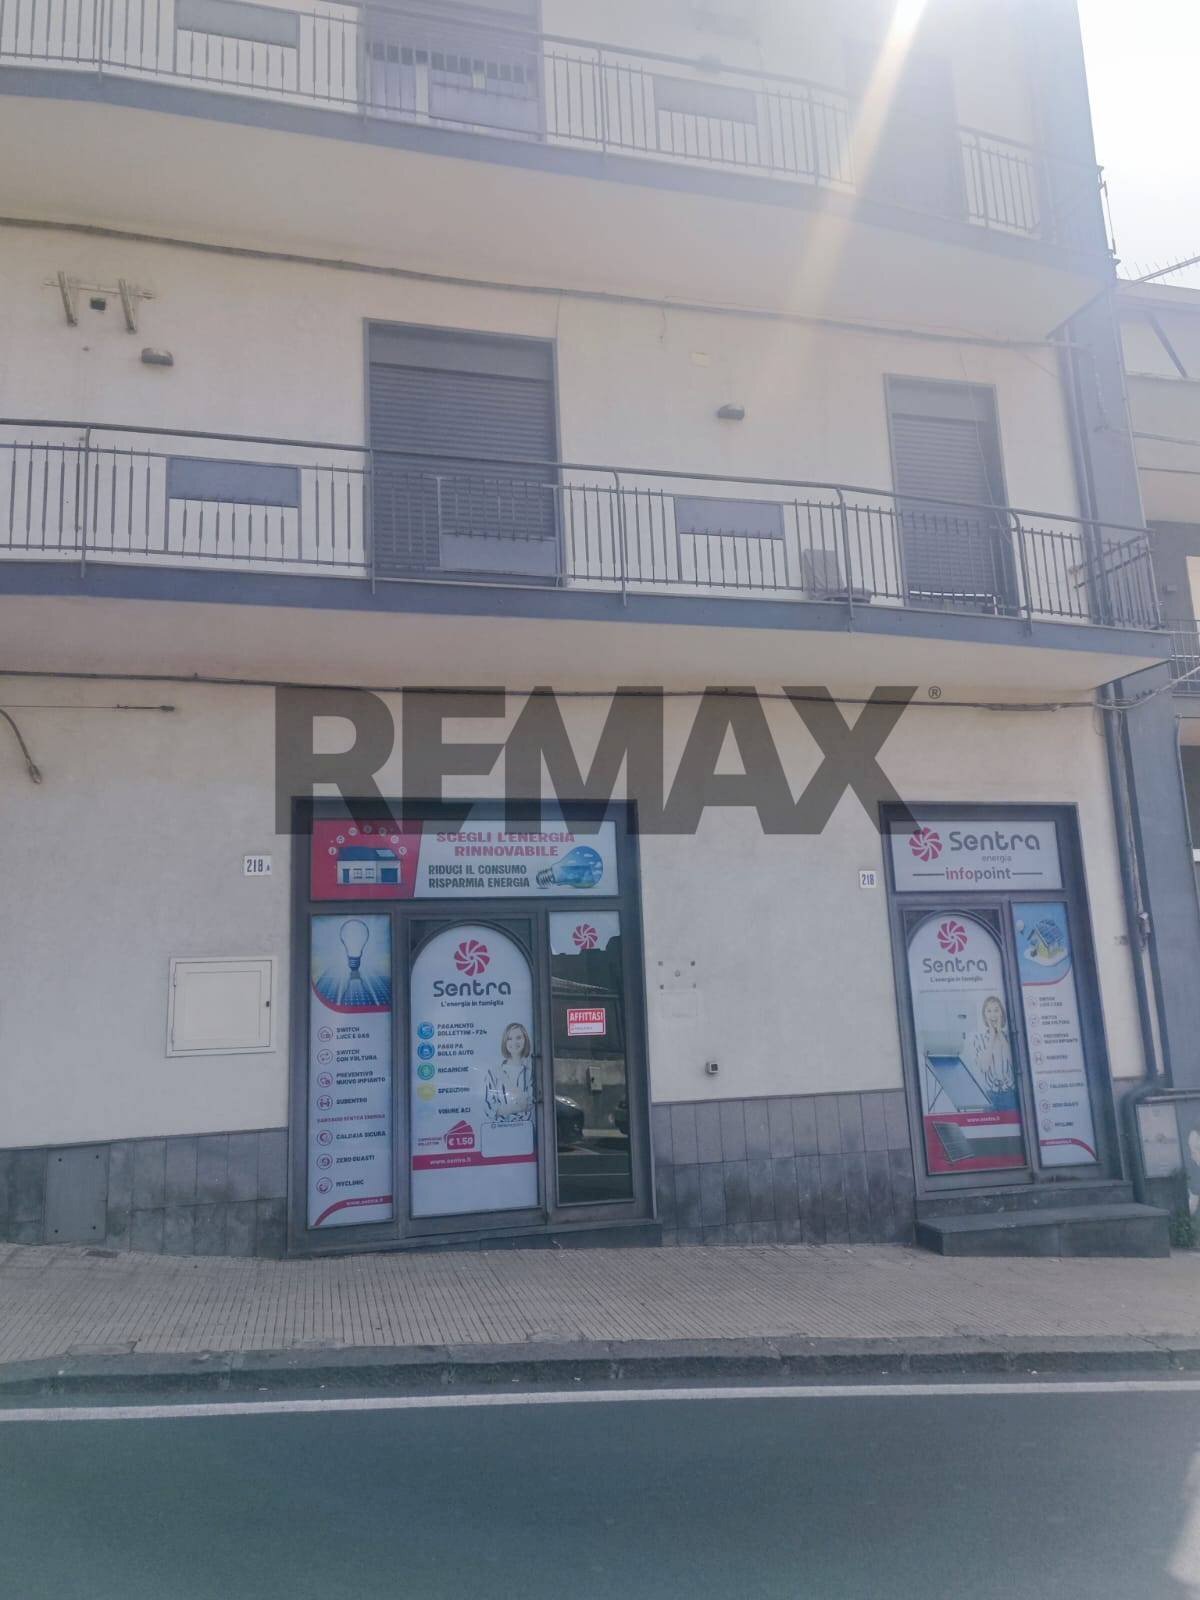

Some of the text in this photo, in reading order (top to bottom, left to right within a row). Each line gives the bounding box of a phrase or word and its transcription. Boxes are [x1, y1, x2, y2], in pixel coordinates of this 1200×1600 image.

[436, 832, 576, 843] SCEGLI L'ENERGIA
[949, 831, 1041, 851] Sentra
[454, 845, 559, 857] RINNOVABILE
[246, 859, 264, 873] 218
[428, 864, 527, 876] RIDUCI IL CONSUMO
[861, 873, 875, 886] 218
[944, 867, 1012, 883] infopoint
[428, 876, 530, 890] RISPARMIA ENERGIA
[922, 956, 988, 974] Sentra
[432, 979, 512, 998] Sentra
[569, 1011, 603, 1021] AFFITTASI
